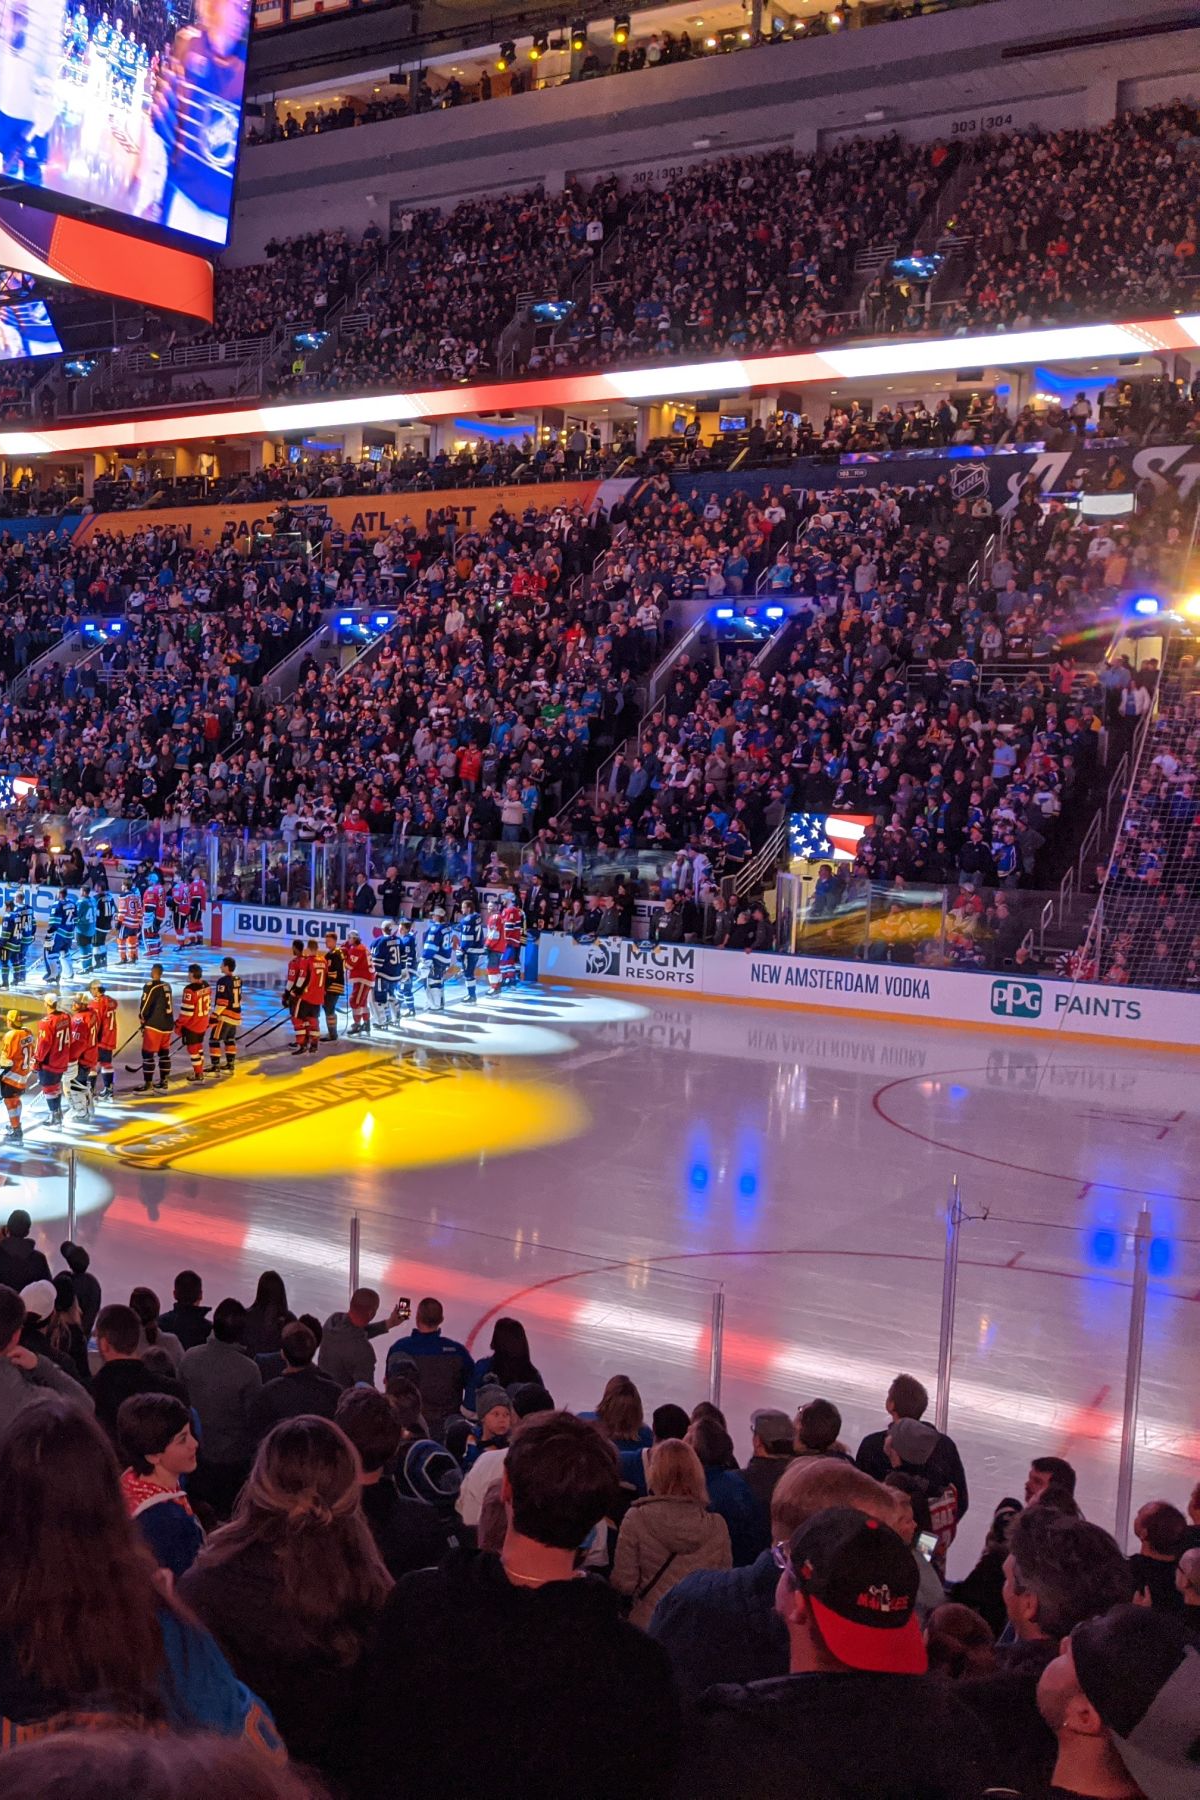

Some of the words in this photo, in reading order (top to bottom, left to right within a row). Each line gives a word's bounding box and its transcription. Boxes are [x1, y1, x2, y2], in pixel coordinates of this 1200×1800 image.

[957, 472, 982, 498] NHL
[351, 511, 392, 532] ATL
[238, 913, 283, 933] BUD
[285, 917, 350, 941] LIGHT
[626, 944, 695, 970] MGM
[315, 968, 325, 988] 7
[626, 966, 695, 985] RESORTS
[751, 963, 780, 984] NEW
[784, 967, 880, 995] AMSTERDAM
[884, 976, 931, 1000] VODKA
[1054, 993, 1142, 1020] PAINTS
[56, 1031, 70, 1052] 74
